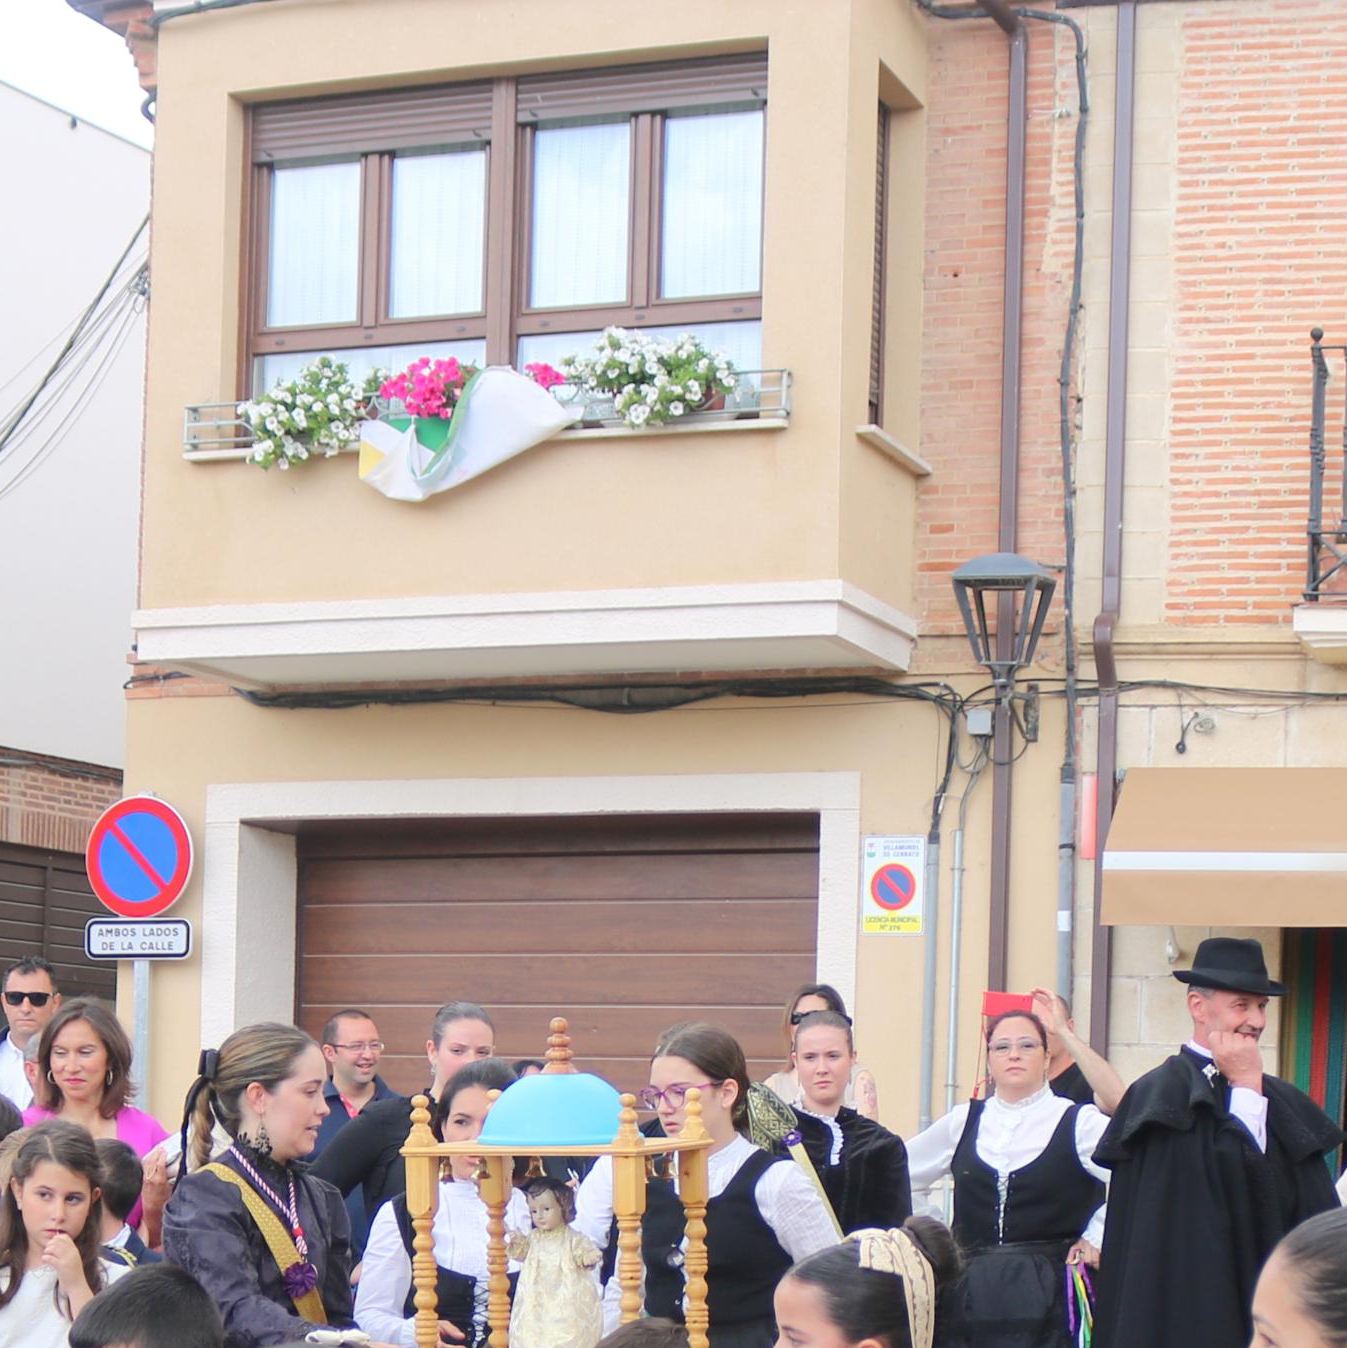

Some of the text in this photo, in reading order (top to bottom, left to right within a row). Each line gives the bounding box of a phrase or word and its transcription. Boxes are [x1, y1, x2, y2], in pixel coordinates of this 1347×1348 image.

[97, 927, 179, 937] AMBOS LADOS
[101, 941, 174, 951] DE LA CALLE
